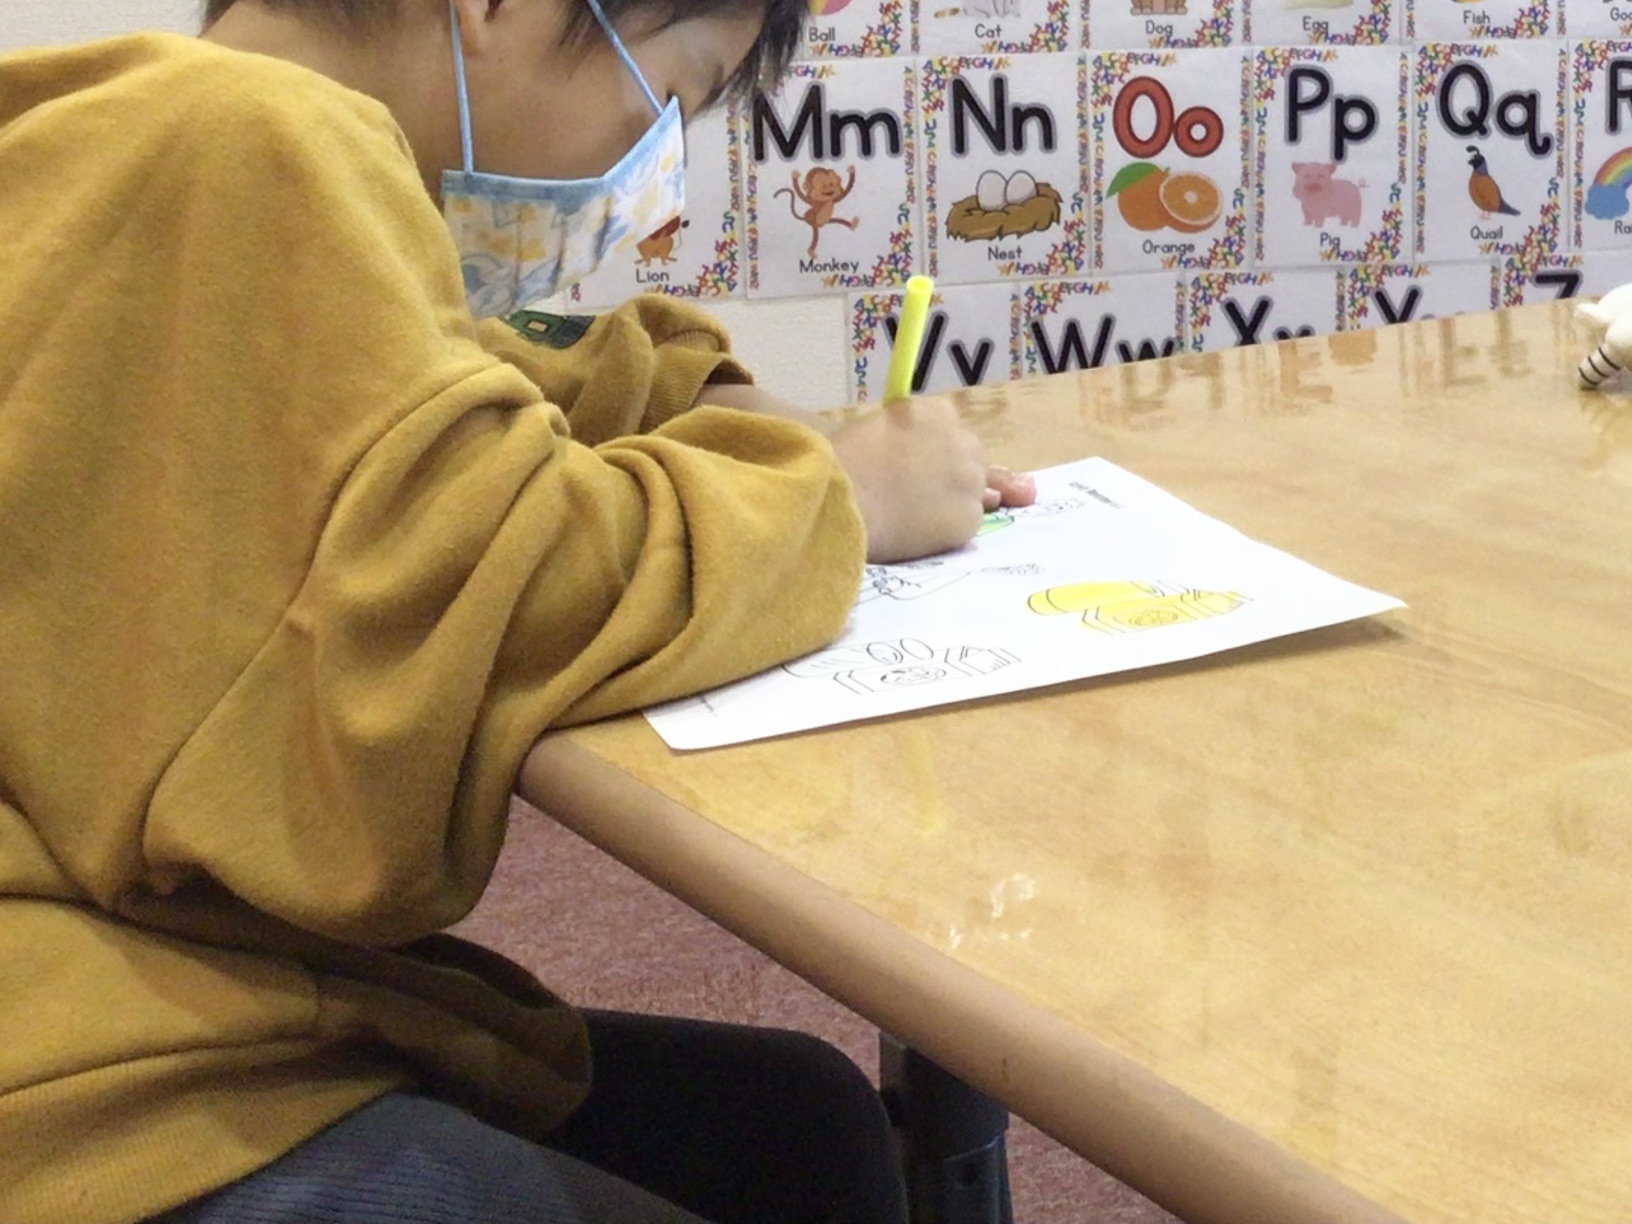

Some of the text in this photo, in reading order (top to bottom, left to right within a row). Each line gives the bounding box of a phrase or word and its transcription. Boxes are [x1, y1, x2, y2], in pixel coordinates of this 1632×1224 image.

[1301, 15, 1330, 33] Egg
[1462, 10, 1491, 26] Fish
[808, 27, 836, 43] Ball
[975, 23, 1002, 40] Cat
[1145, 20, 1174, 38] Dog
[947, 72, 1059, 157] Nn
[1112, 75, 1225, 160] Oo
[1283, 63, 1380, 165] Pp
[1434, 59, 1555, 159] Qq
[751, 80, 901, 163] Mm
[1319, 231, 1341, 252] Pig
[1469, 225, 1504, 241] Quail
[987, 245, 1023, 263] Nest
[1142, 239, 1196, 259] Orange
[634, 267, 670, 284] Lion
[799, 257, 860, 276] Monkey
